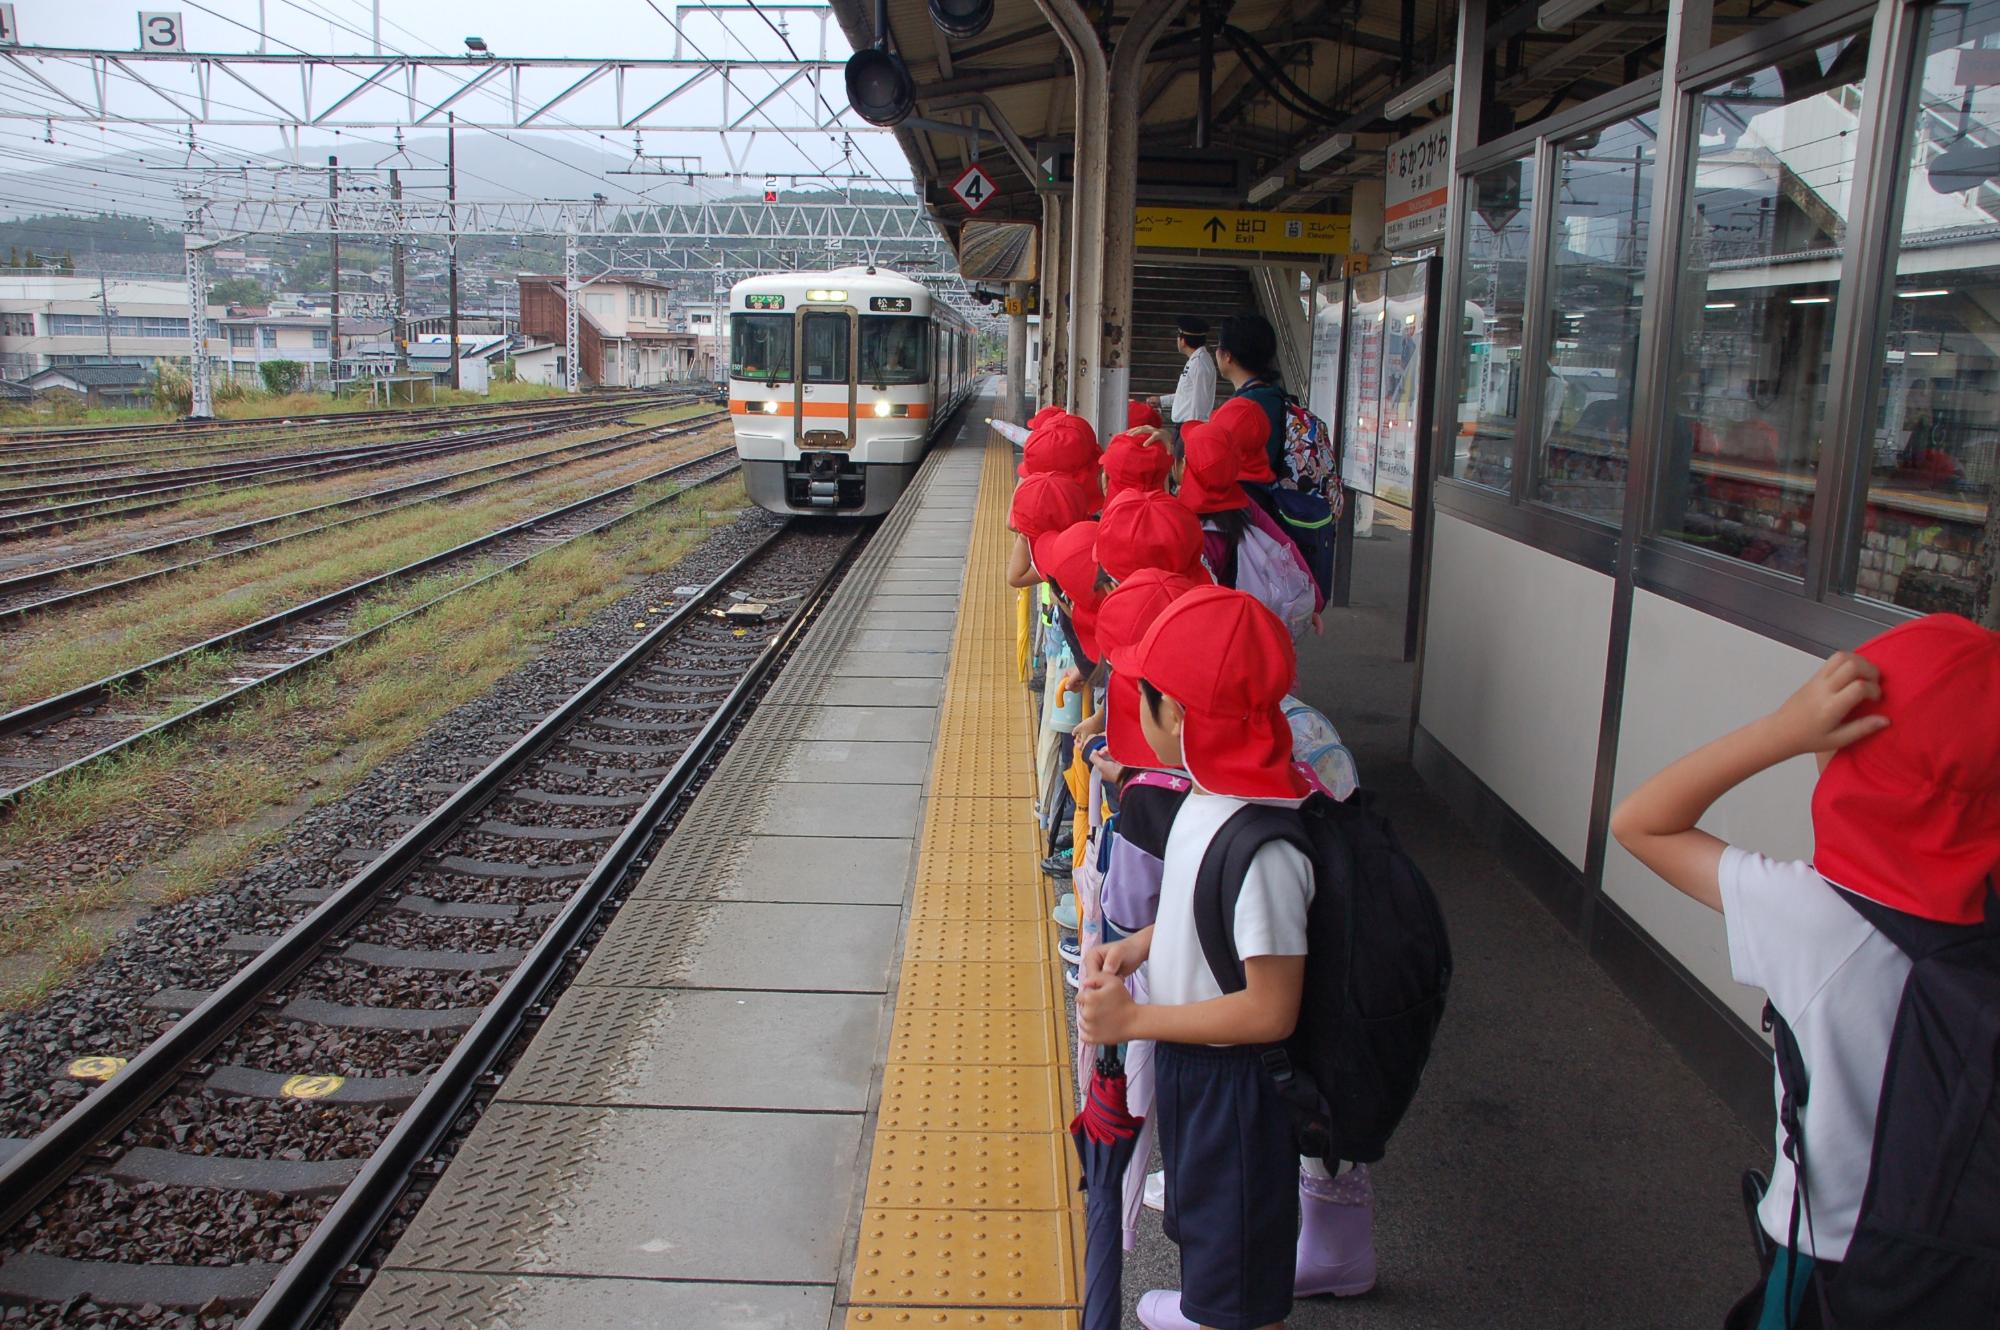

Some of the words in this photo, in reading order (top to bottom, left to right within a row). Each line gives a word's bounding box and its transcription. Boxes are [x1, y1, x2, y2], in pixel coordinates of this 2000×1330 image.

[148, 16, 177, 46] 3
[1399, 129, 1448, 178] なかつがわ
[765, 176, 777, 187] 2
[965, 175, 983, 202] 4
[1235, 218, 1266, 232] 出口
[830, 239, 840, 248] 2
[1235, 235, 1255, 244] Exit
[750, 295, 783, 303] ワンマン
[877, 298, 905, 308] 松本
[1008, 301, 1018, 312] 15
